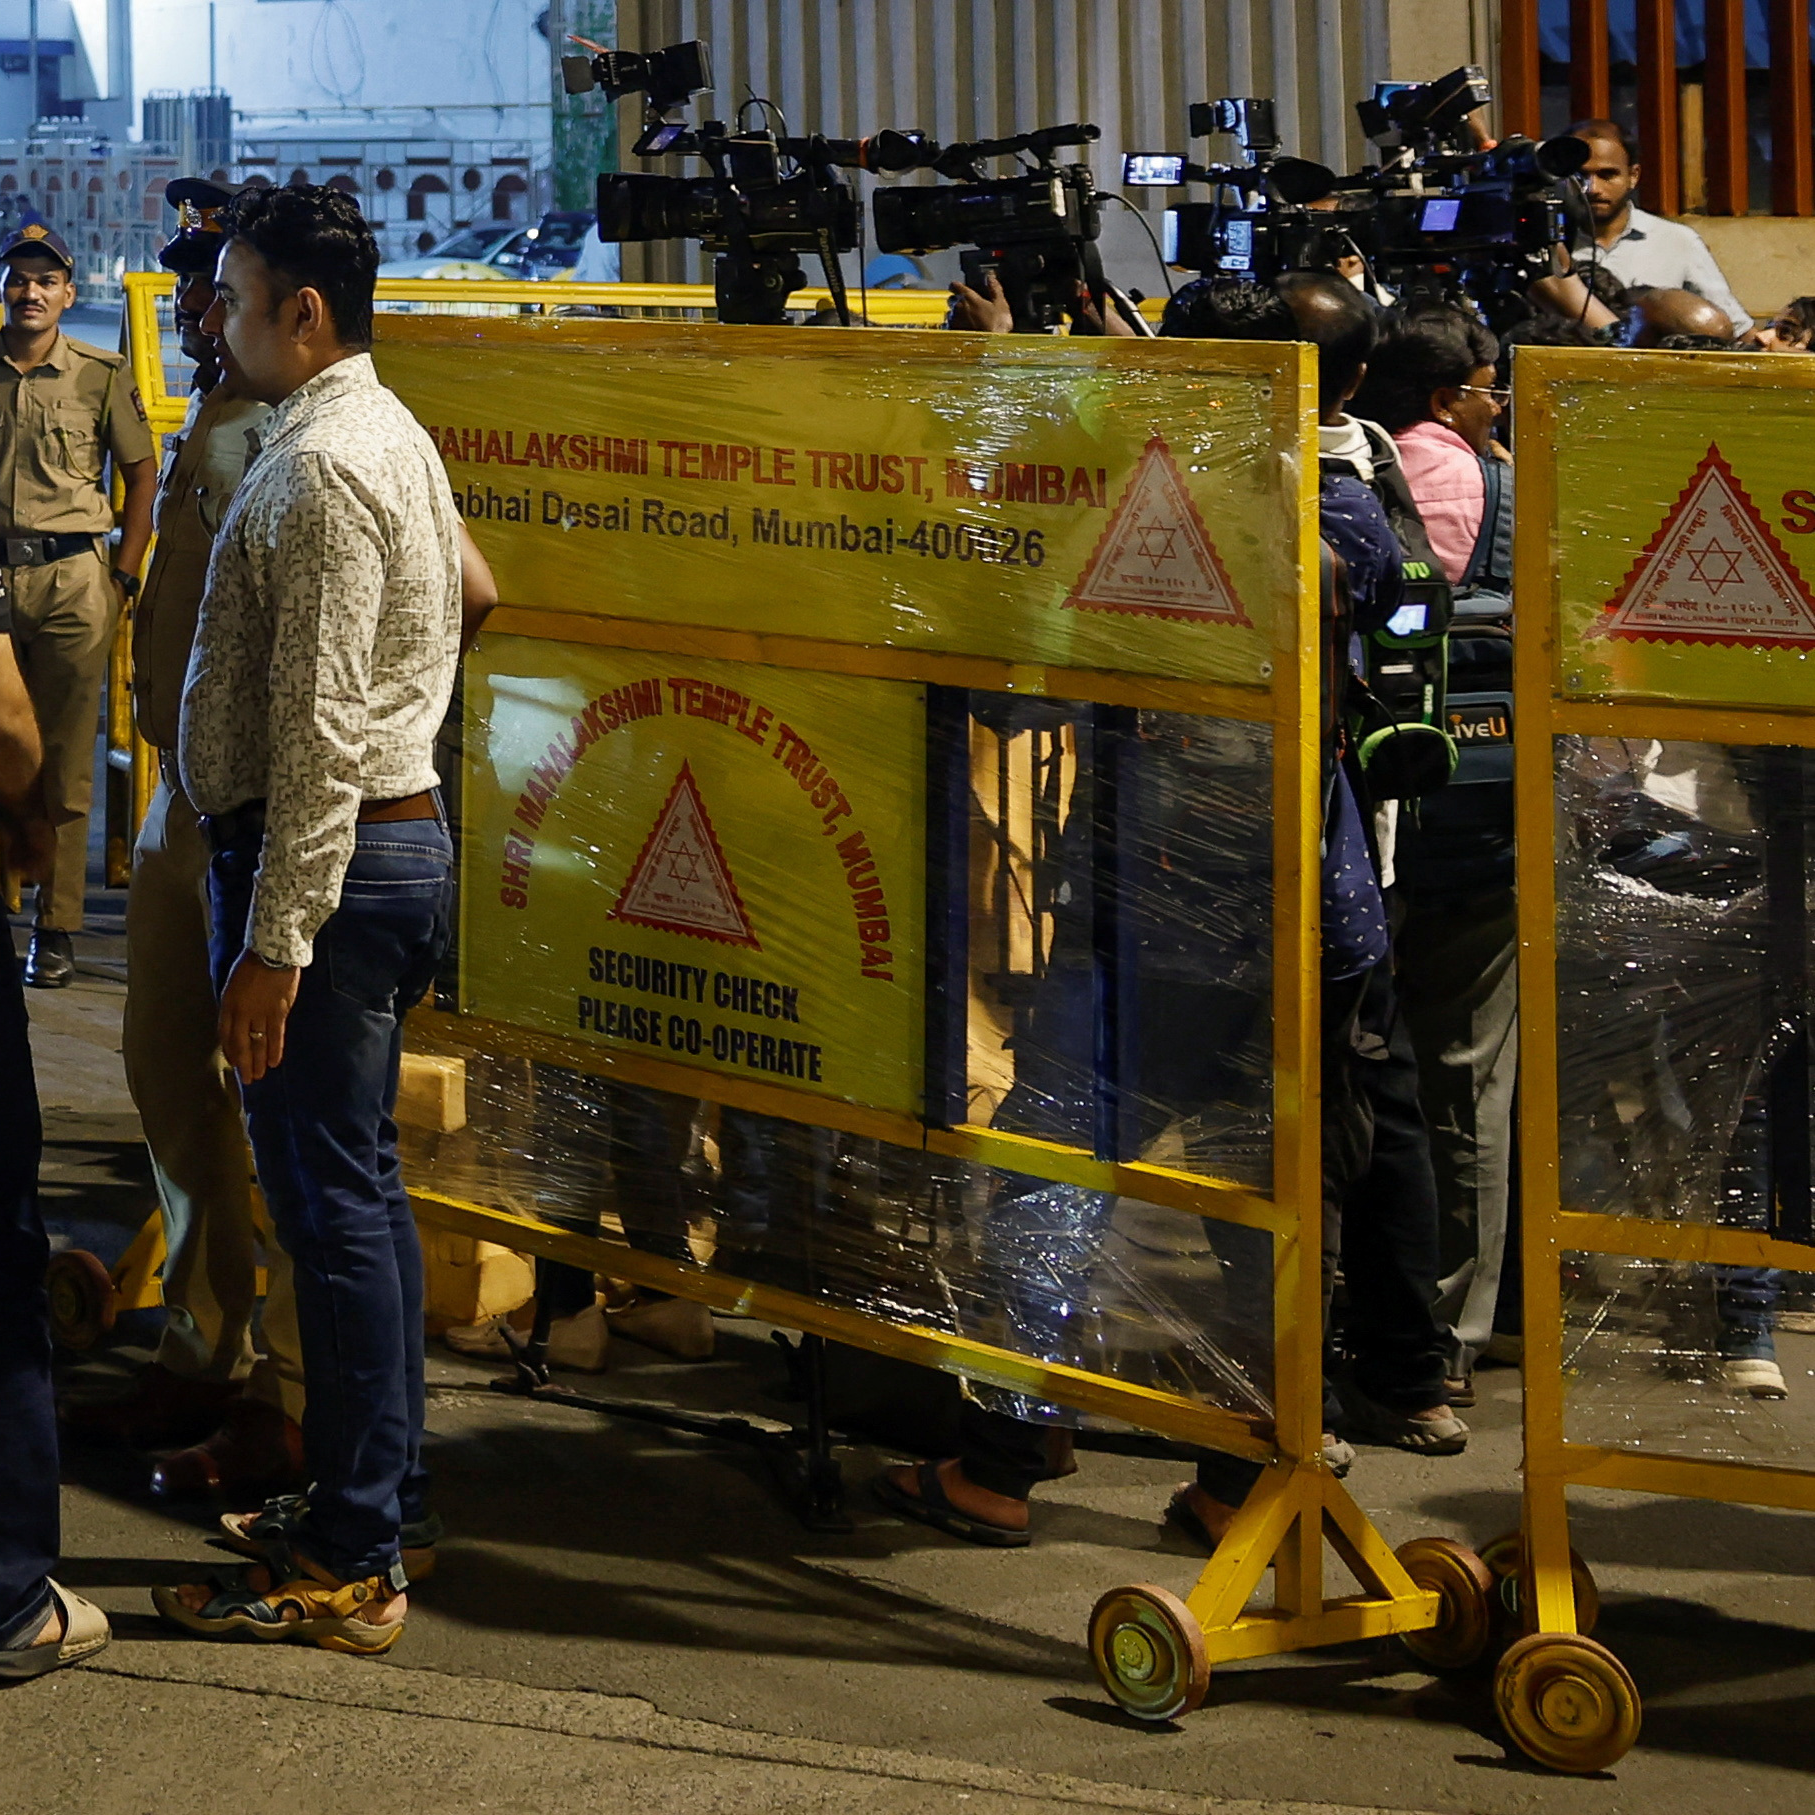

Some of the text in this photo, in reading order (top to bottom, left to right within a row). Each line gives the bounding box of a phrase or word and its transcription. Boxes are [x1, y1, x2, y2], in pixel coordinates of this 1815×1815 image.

[658, 440, 796, 486] TEMPLE
[805, 450, 932, 503] TRUST,
[946, 457, 1106, 508] MUMBAI
[543, 491, 630, 529] Desai
[643, 499, 739, 544] Road,
[753, 507, 1044, 567] Mumbai-400026
[667, 677, 775, 747] TEMPLE
[514, 679, 662, 832] MAHALAKSHMI
[769, 723, 853, 837] TRUST,
[501, 828, 535, 910] SHRI
[835, 830, 894, 982] MUMBAI
[589, 947, 800, 1023] SECURITY CHECK
[578, 995, 823, 1082] PLEASE CO-OPERATE
